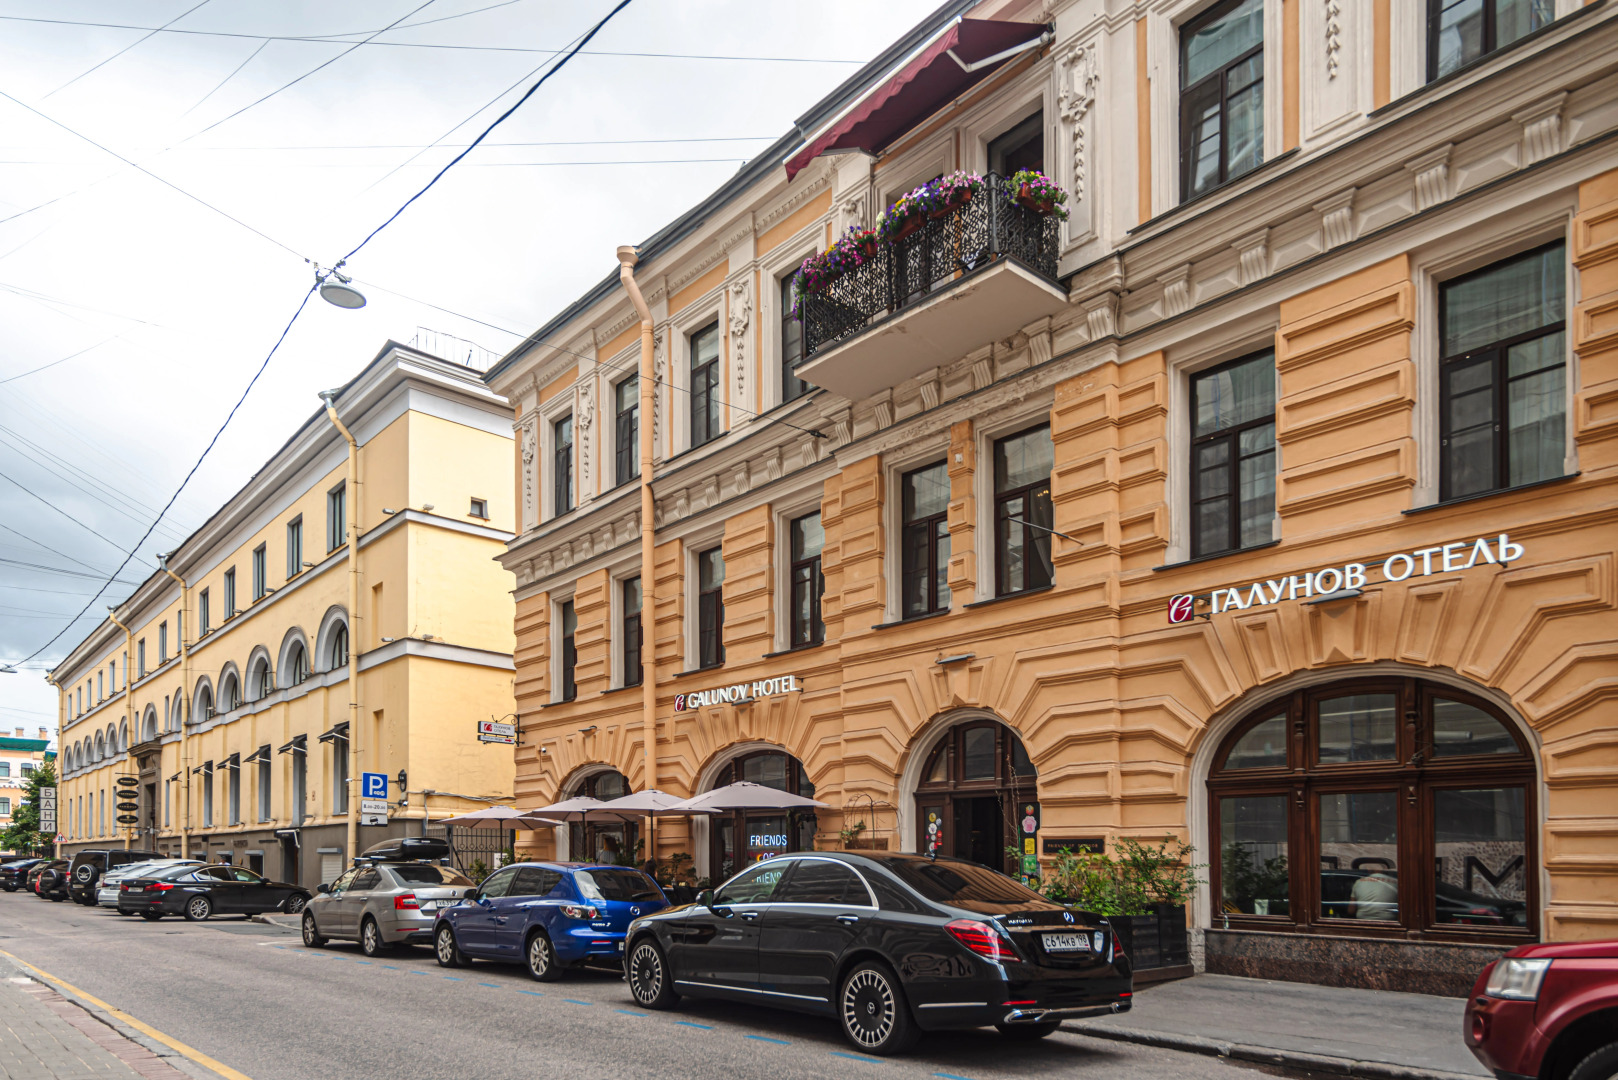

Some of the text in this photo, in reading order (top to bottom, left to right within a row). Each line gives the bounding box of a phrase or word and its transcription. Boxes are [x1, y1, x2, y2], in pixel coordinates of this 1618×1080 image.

[1211, 534, 1525, 614] ГАЛУНОВ ОТЕЛЬ
[688, 684, 750, 708] GALUNOV
[753, 675, 800, 698] HOTEL
[44, 788, 52, 831] БАНИ
[750, 834, 788, 846] FRIENDS
